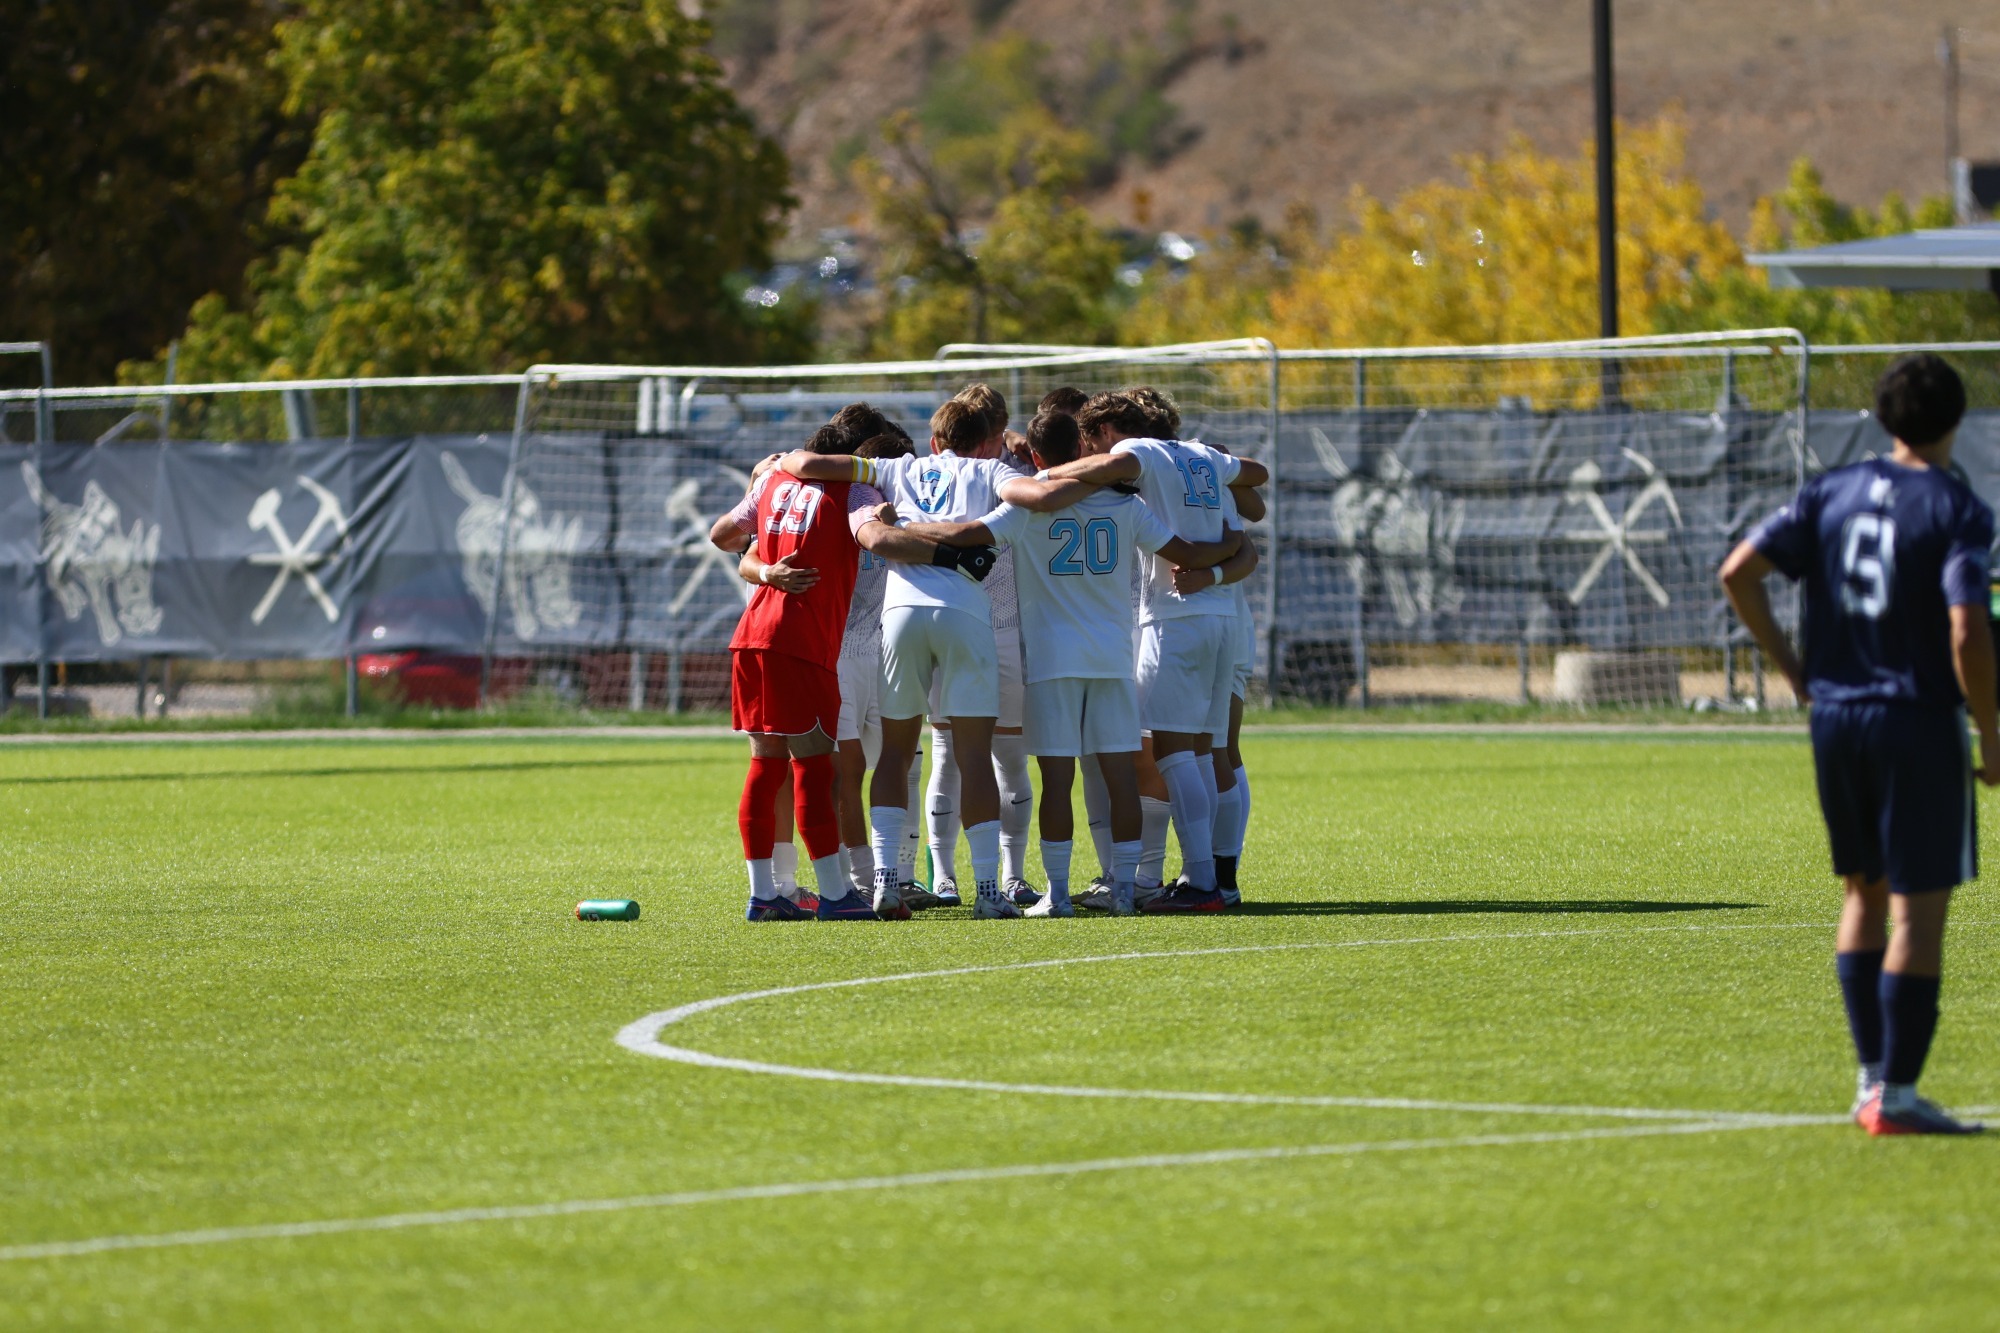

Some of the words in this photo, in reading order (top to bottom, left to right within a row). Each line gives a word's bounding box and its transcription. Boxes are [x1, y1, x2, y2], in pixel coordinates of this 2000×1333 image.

[765, 480, 824, 535] 99
[915, 468, 953, 514] 3
[1174, 456, 1220, 509] 13
[1049, 517, 1118, 576] 20
